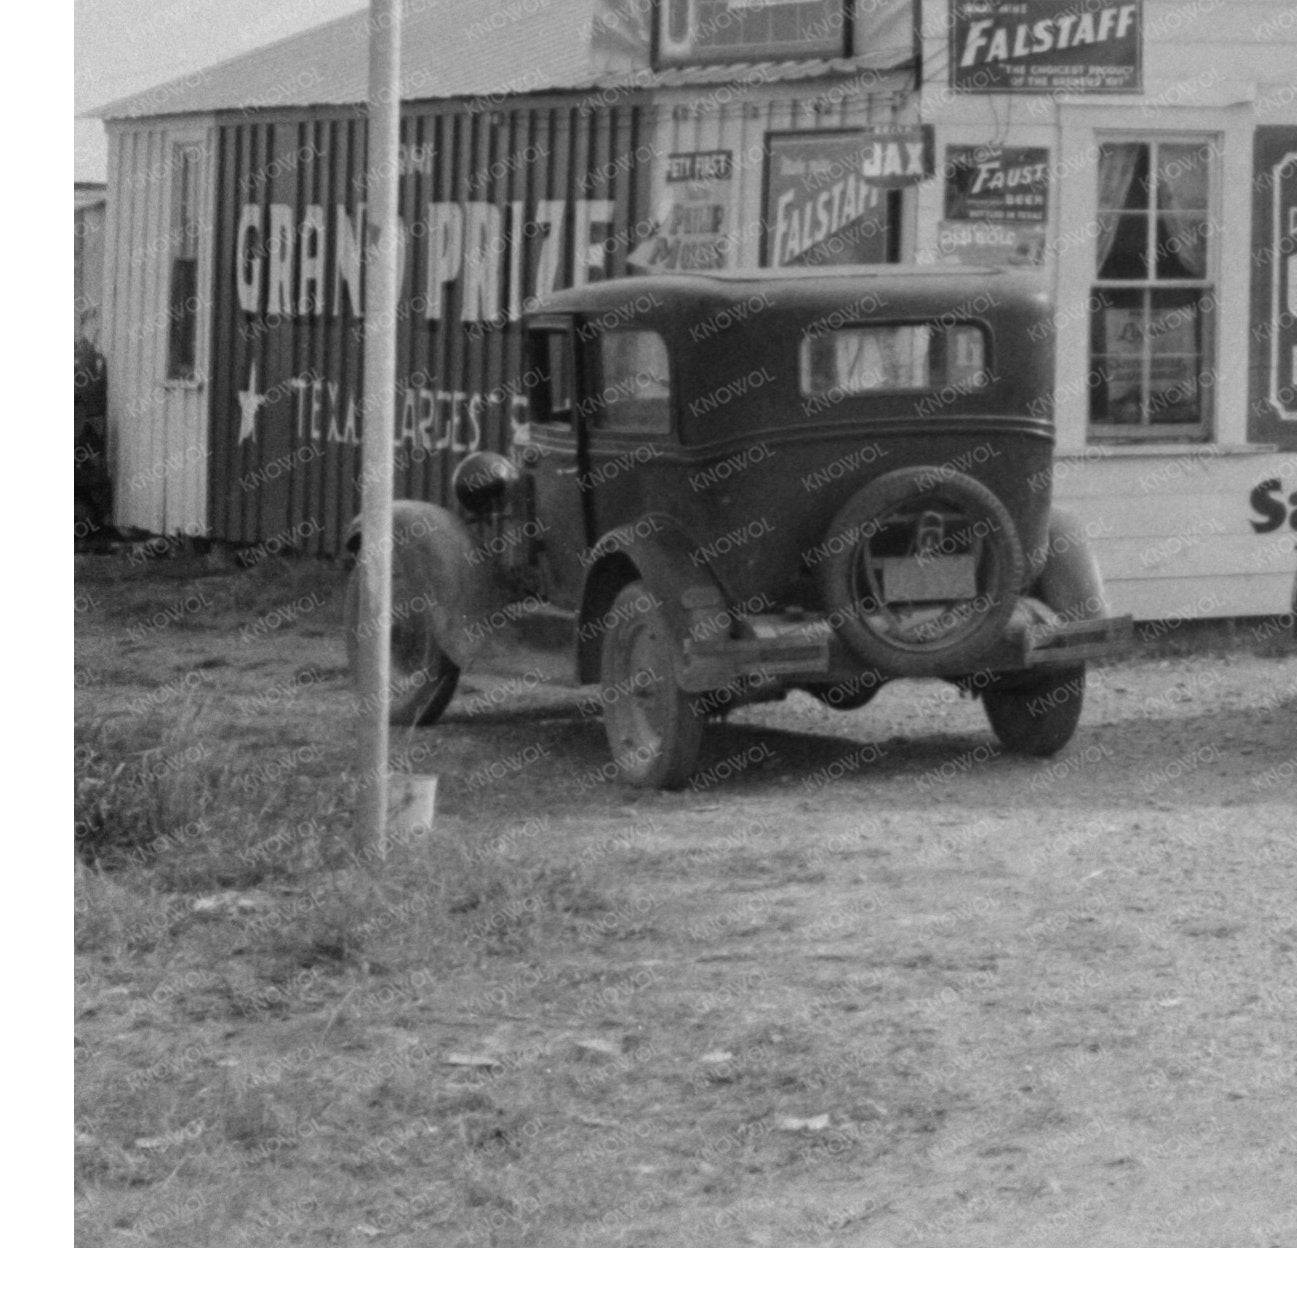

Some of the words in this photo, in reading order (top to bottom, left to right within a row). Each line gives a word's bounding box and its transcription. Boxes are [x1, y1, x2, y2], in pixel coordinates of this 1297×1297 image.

[959, 5, 1137, 68] FALSTAFF
[861, 142, 924, 177] JAX
[970, 160, 1047, 194] FAUST
[237, 203, 404, 318] GRAN
[426, 199, 616, 322] PRIZE
[290, 378, 360, 444] TEXA
